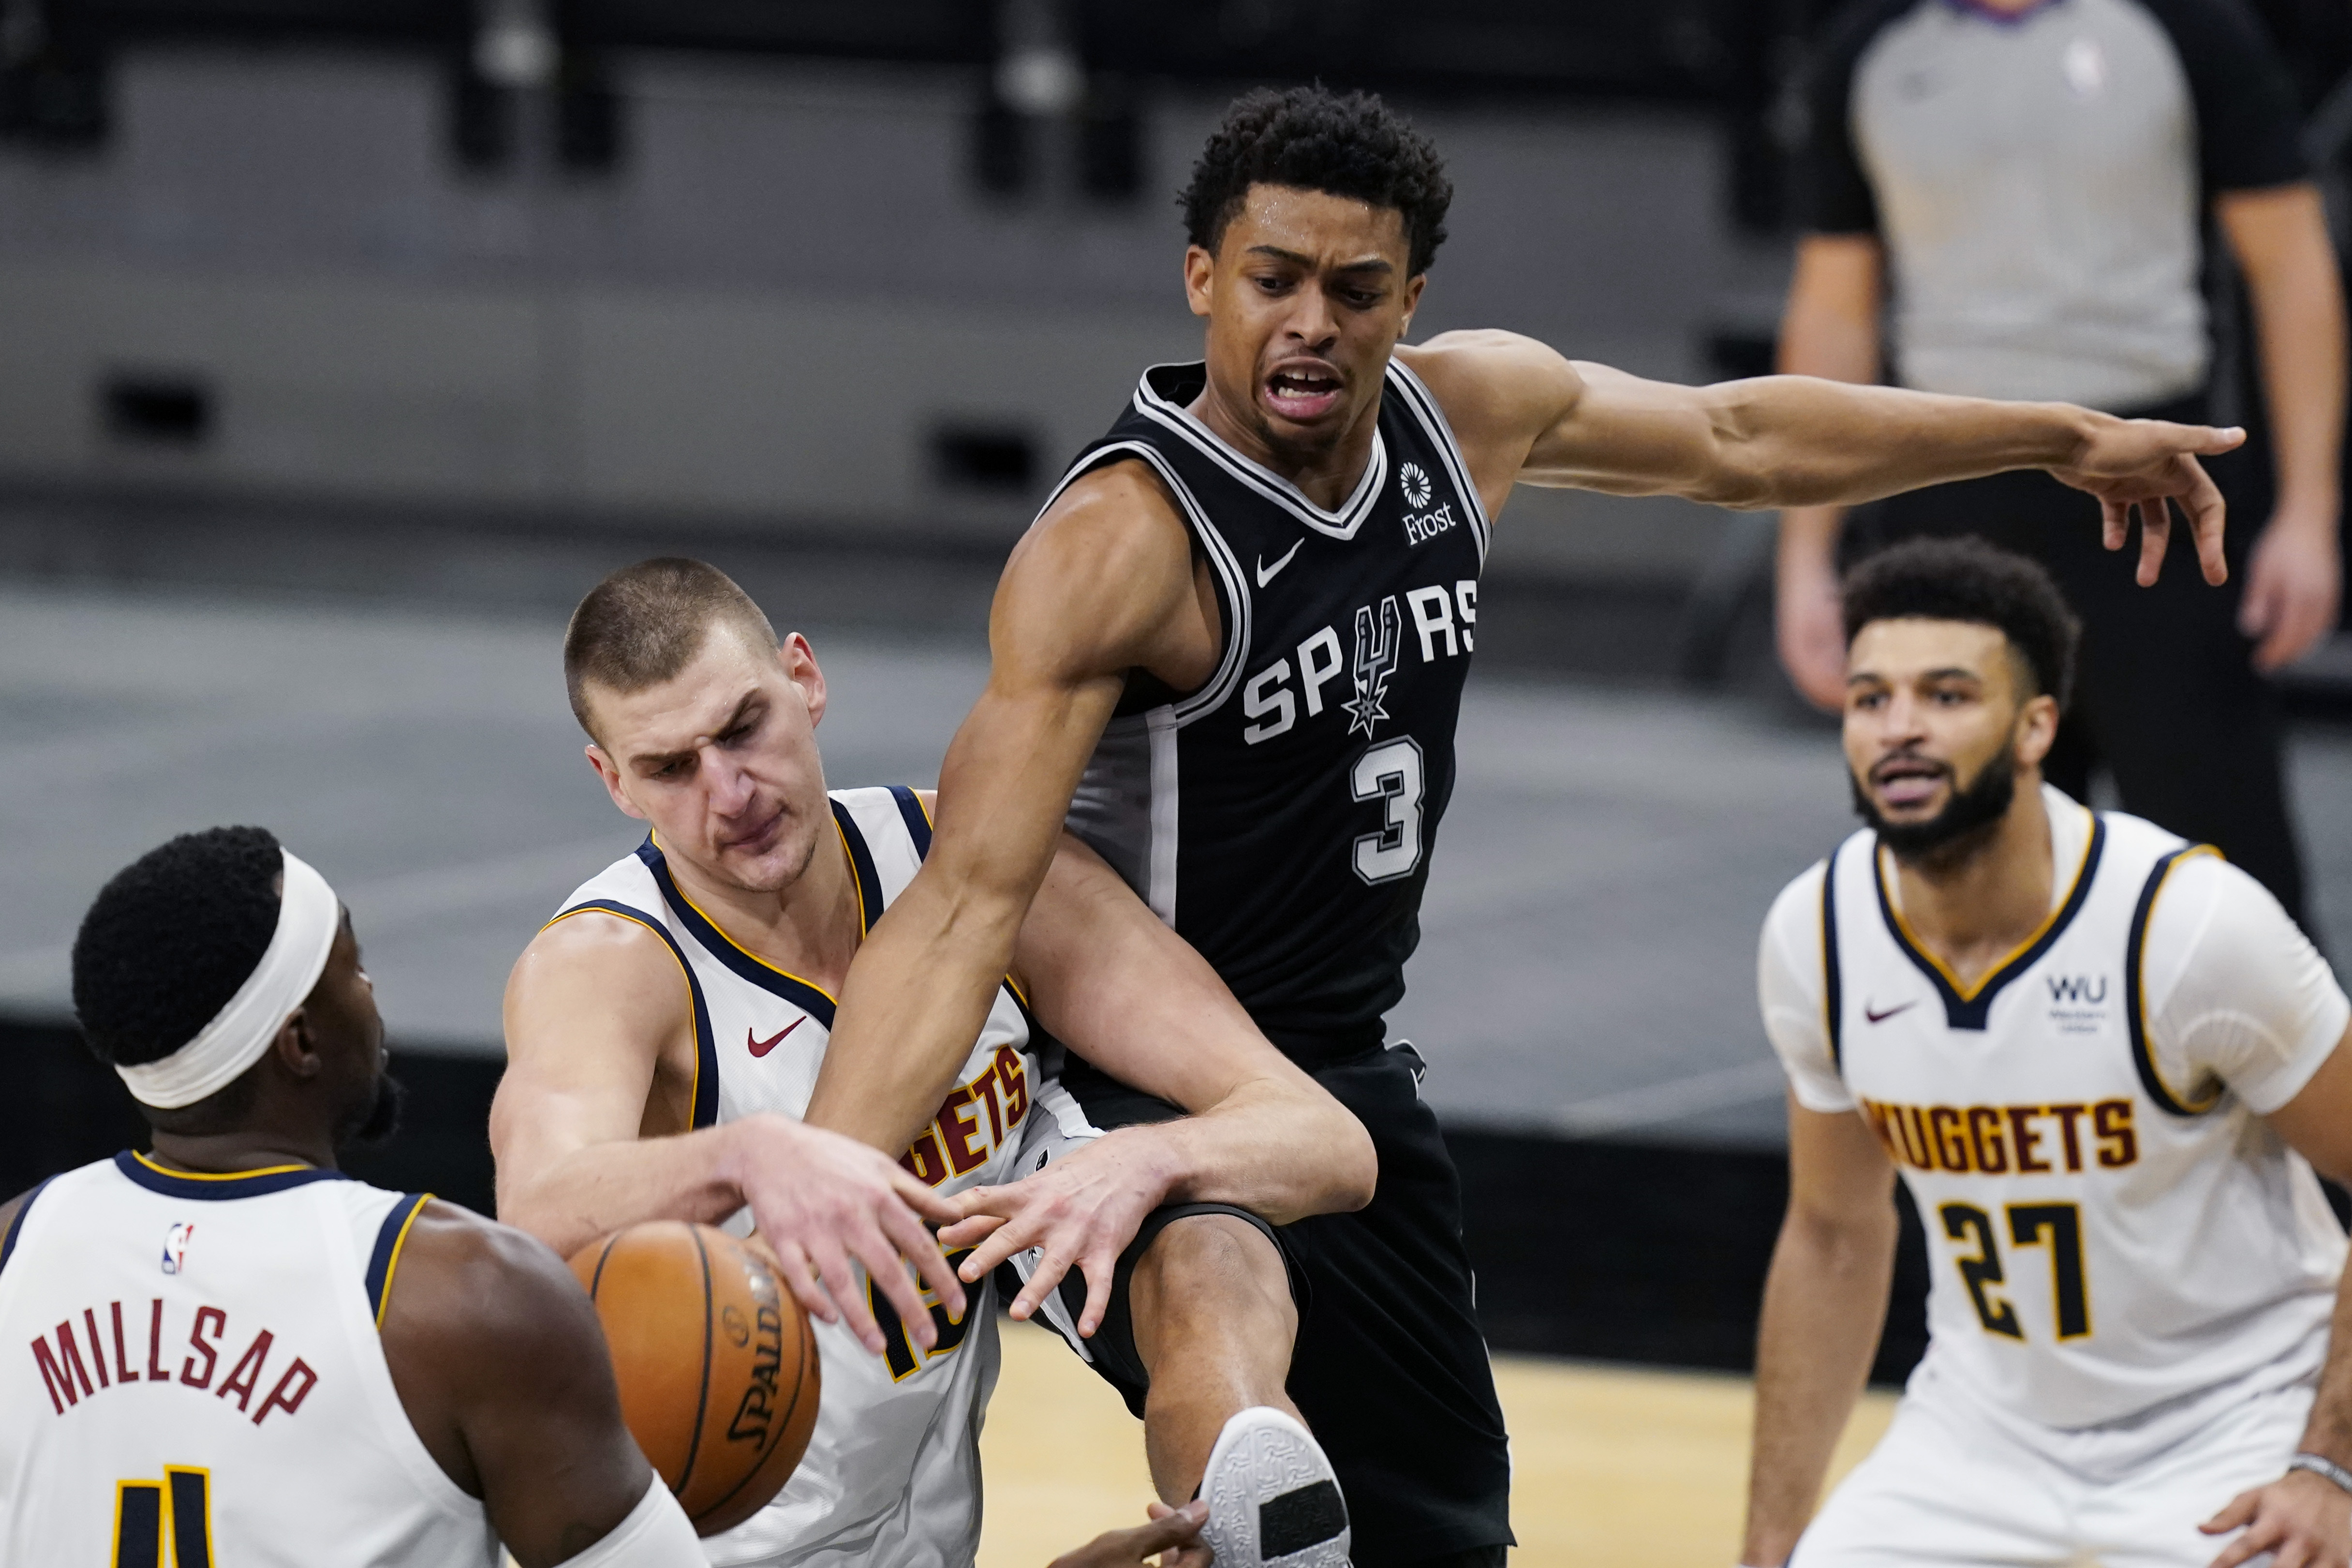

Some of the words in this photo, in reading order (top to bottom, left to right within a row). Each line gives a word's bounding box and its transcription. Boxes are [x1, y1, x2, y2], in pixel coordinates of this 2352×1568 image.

[1402, 502, 1456, 546] Frost
[1243, 580, 1477, 745] SPURS
[1351, 734, 1425, 886] 3
[2047, 977, 2106, 1004] WU
[898, 1043, 1029, 1189] GETS
[1938, 1198, 2092, 1344] 27
[31, 1298, 318, 1426] MILLSAP
